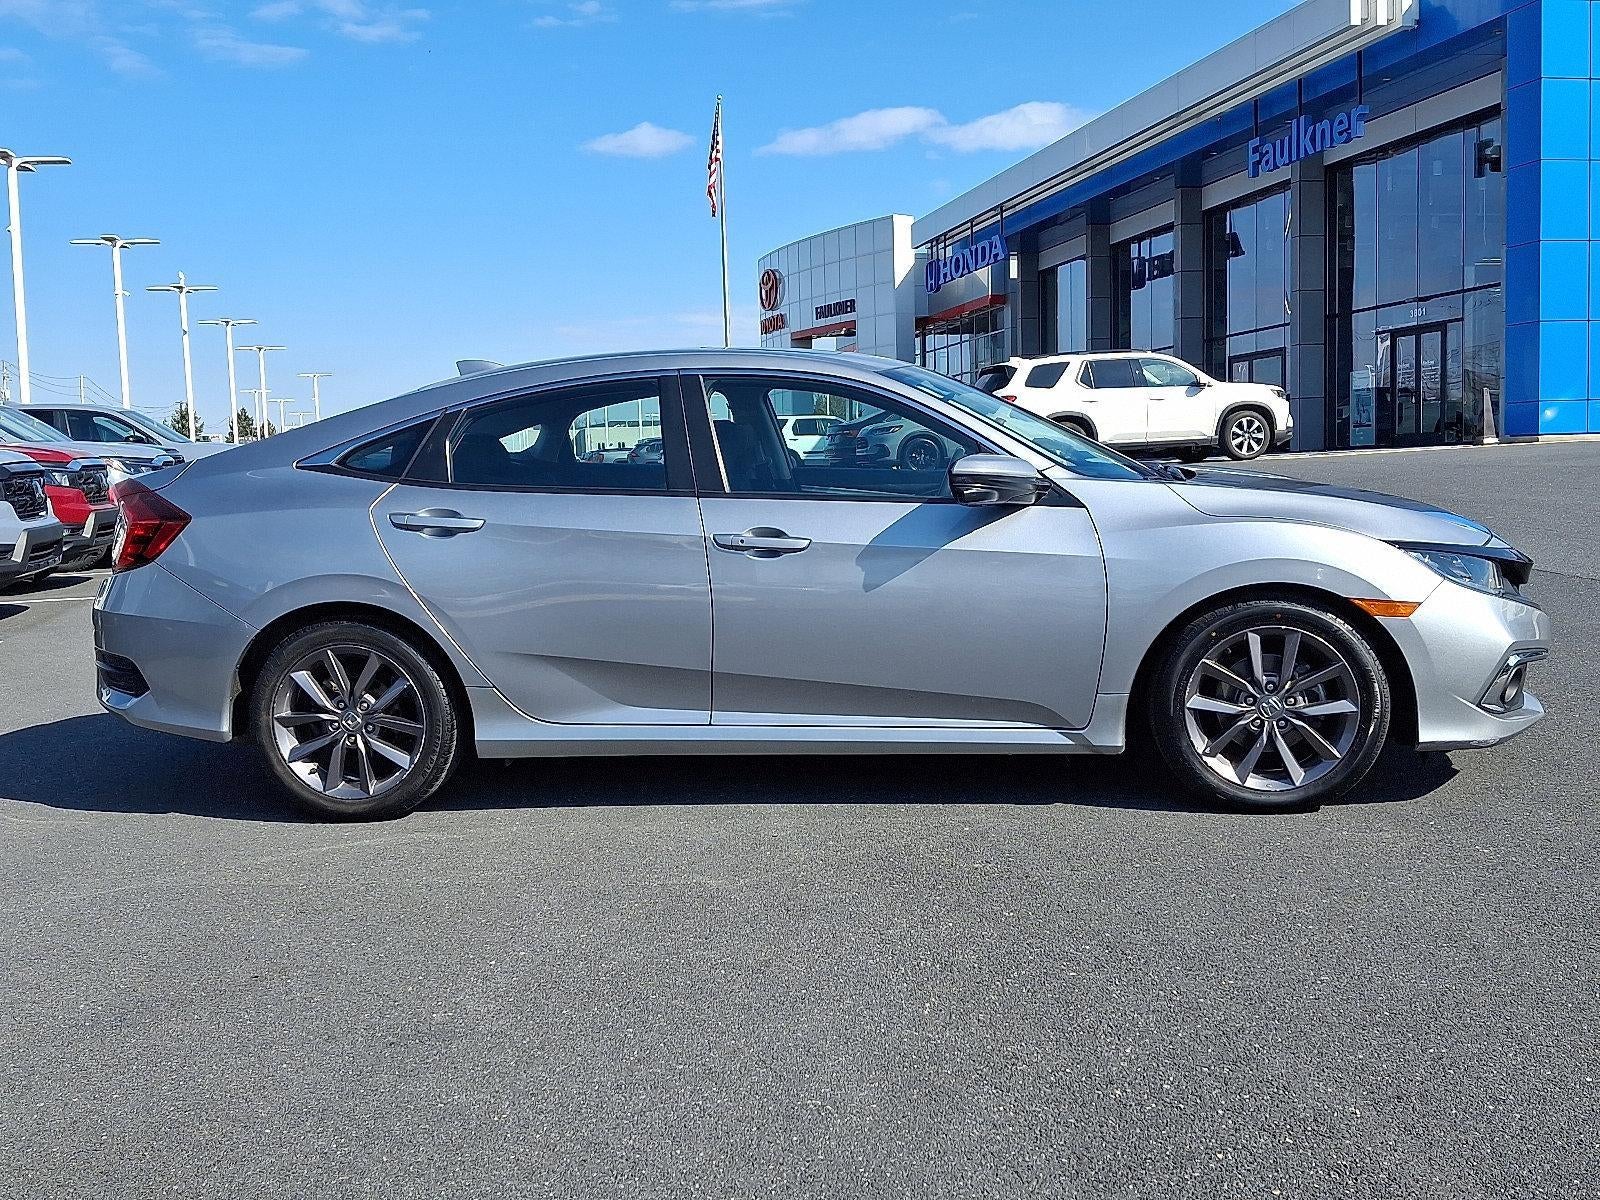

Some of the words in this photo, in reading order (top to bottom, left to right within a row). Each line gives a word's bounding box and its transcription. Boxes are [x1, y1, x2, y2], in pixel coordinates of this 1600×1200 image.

[1248, 104, 1369, 178] Faulkner
[938, 234, 1006, 285] HONDA
[815, 298, 856, 320] FAULKNER
[1409, 306, 1426, 318] 3801
